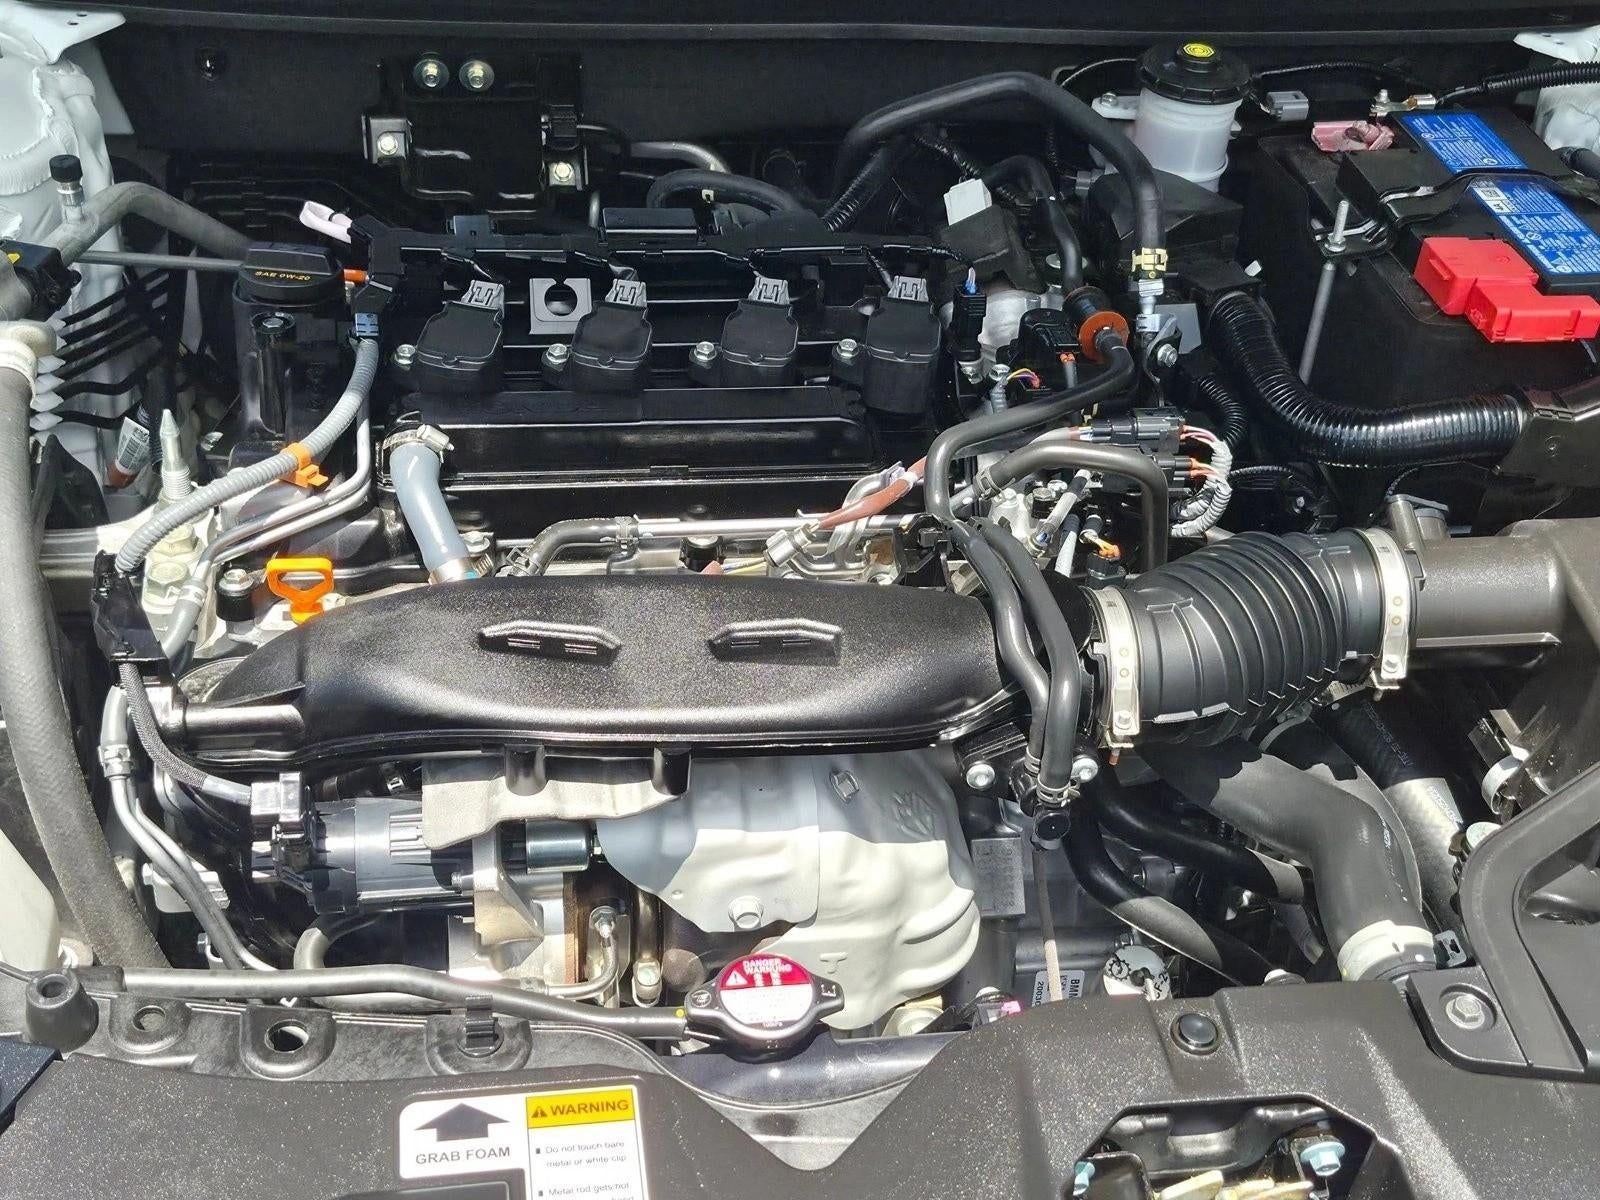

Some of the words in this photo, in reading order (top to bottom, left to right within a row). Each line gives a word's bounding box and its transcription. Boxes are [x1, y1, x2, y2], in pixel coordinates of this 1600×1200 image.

[279, 273, 311, 281] 0W-20
[550, 1099, 630, 1116] WARNING
[545, 1145, 559, 1154] Do
[561, 1144, 576, 1152] not
[577, 1143, 603, 1152] touch
[604, 1141, 625, 1149] bare
[415, 1151, 461, 1165] GRAB
[466, 1146, 511, 1160] FOAM
[546, 1159, 572, 1167] metal
[585, 1156, 609, 1164] white
[548, 1187, 574, 1196] Metal
[576, 1185, 591, 1193] rod
[593, 1183, 613, 1193] gets
